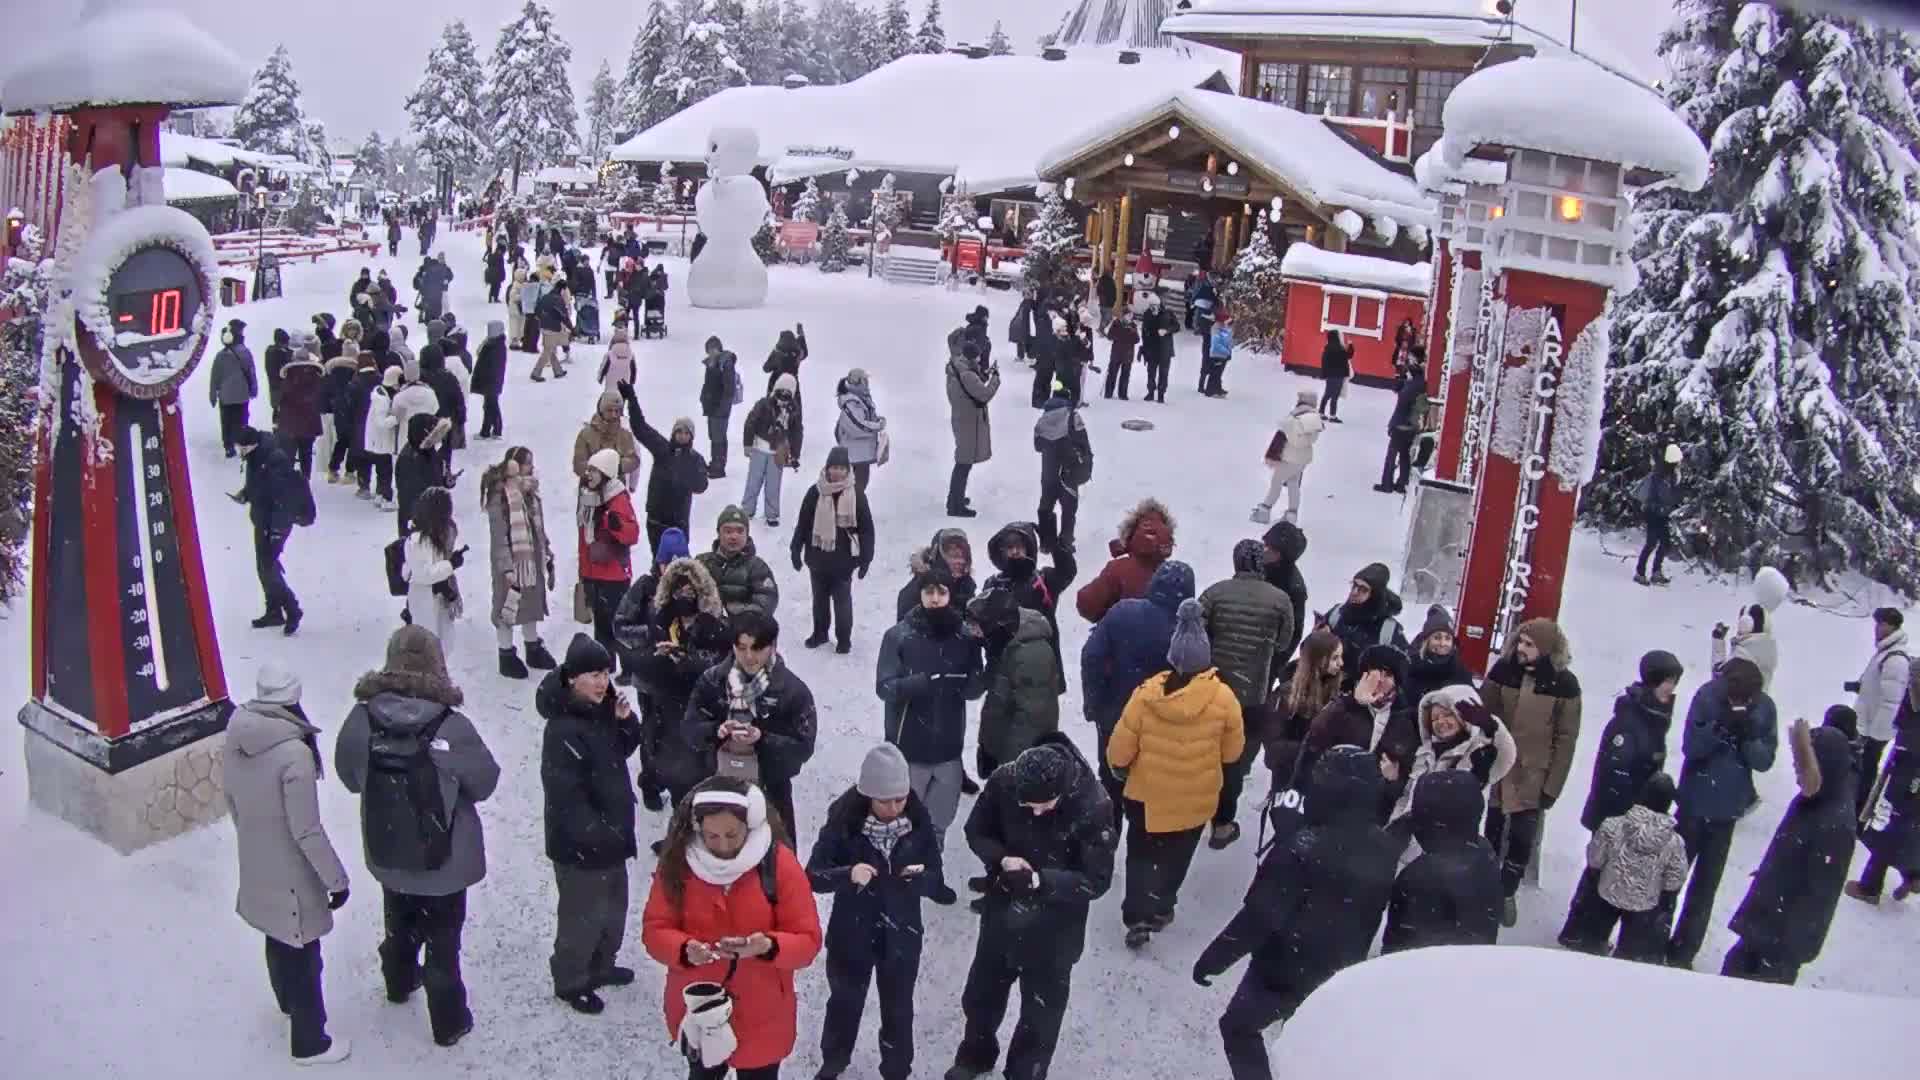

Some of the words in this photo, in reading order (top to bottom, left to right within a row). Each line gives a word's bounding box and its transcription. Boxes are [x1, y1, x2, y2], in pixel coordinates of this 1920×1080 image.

[1473, 279, 1494, 369] ARCTIC
[1525, 316, 1562, 480] ARCTIC
[1462, 383, 1486, 475] CIRCLE
[145, 434, 159, 449] 40
[147, 463, 161, 478] 30
[149, 490, 163, 507] 20
[152, 519, 166, 535] 10
[133, 554, 141, 569] 0
[155, 548, 163, 563] 0
[1506, 503, 1541, 614] CIRC
[128, 582, 143, 597] -10
[130, 609, 147, 624] -20
[132, 635, 150, 650] -30
[136, 662, 154, 678] -40
